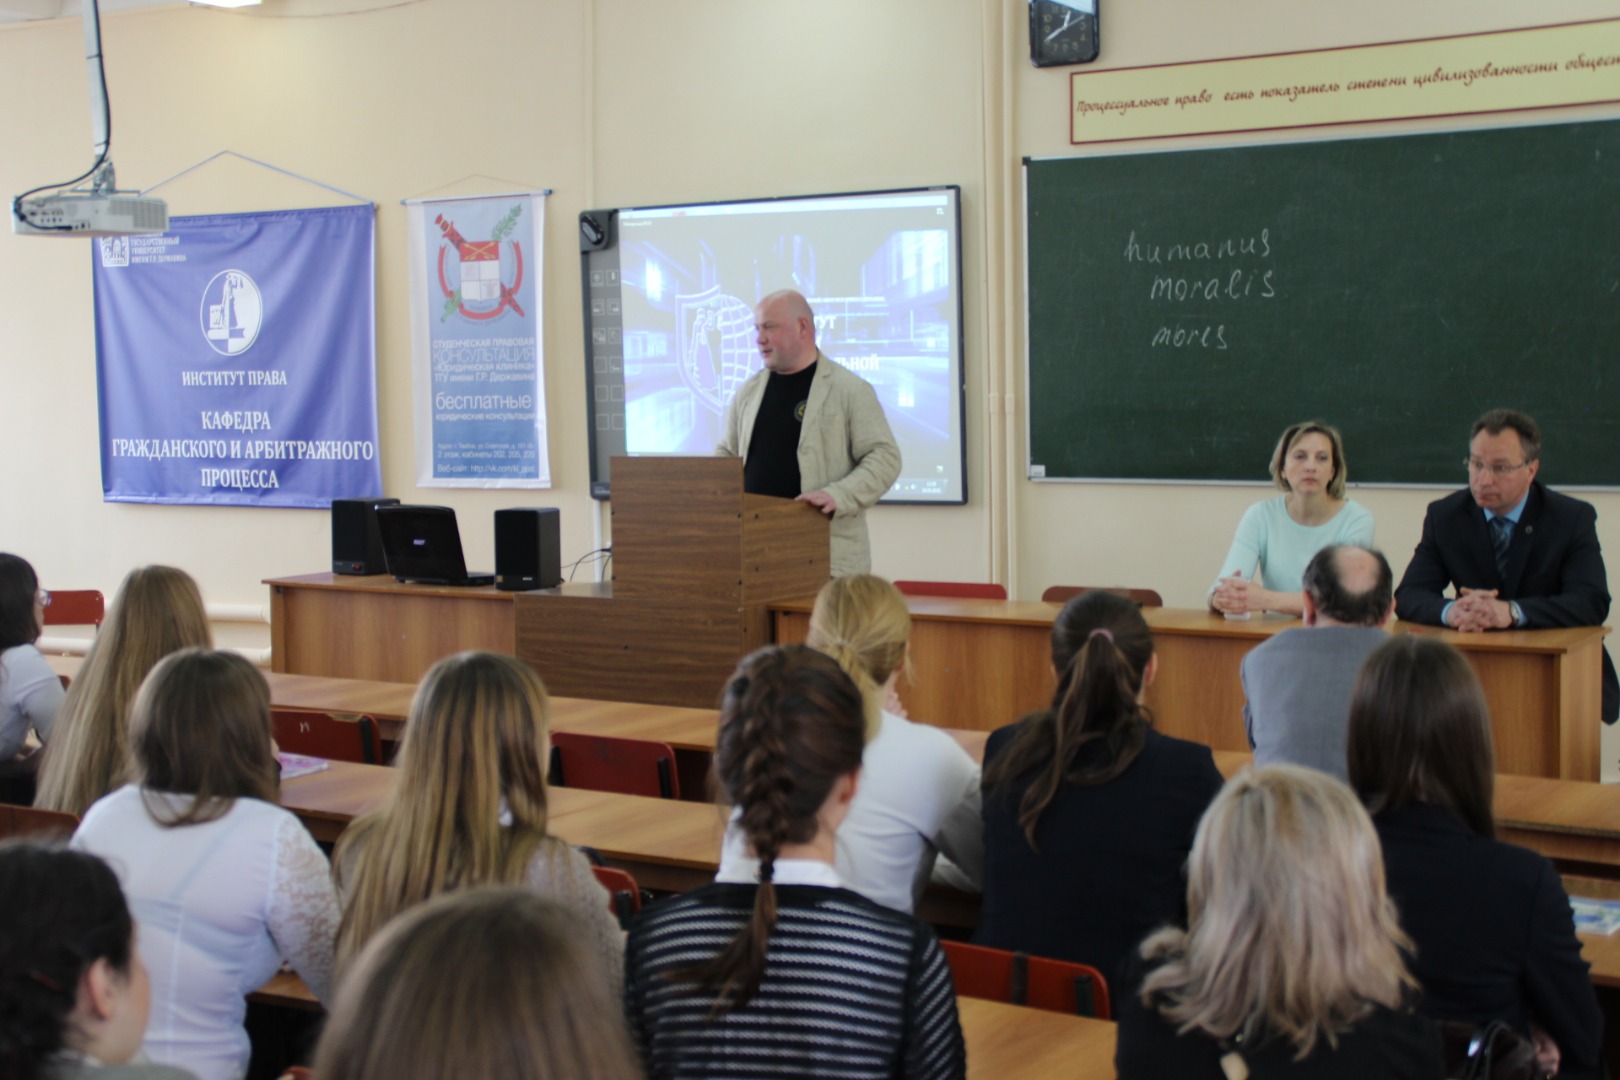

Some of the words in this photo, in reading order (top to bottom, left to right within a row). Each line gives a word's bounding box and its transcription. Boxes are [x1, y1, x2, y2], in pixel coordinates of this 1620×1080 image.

[1076, 96, 1170, 116] Процессуальное
[1175, 88, 1213, 110] право
[1224, 89, 1254, 102] есть
[1260, 82, 1340, 102] показатель
[1346, 77, 1407, 92] степени
[1413, 61, 1558, 87] цивилизованности
[1124, 228, 1271, 264] humanus
[1151, 269, 1275, 301] moralis
[433, 347, 535, 363] КОНСУЛЬТАЦИЯ
[182, 371, 245, 386] ИНСТИТУТ
[248, 371, 287, 386] ПРАВА
[435, 392, 532, 410] бесплатные
[201, 411, 271, 433] КАФЕДРА
[112, 439, 226, 461] ГРАЖДАНСКОГО
[230, 440, 241, 458] И
[245, 441, 374, 460] АРБИТРАЖНОГО
[201, 468, 279, 491] ПРОЦЕССА
